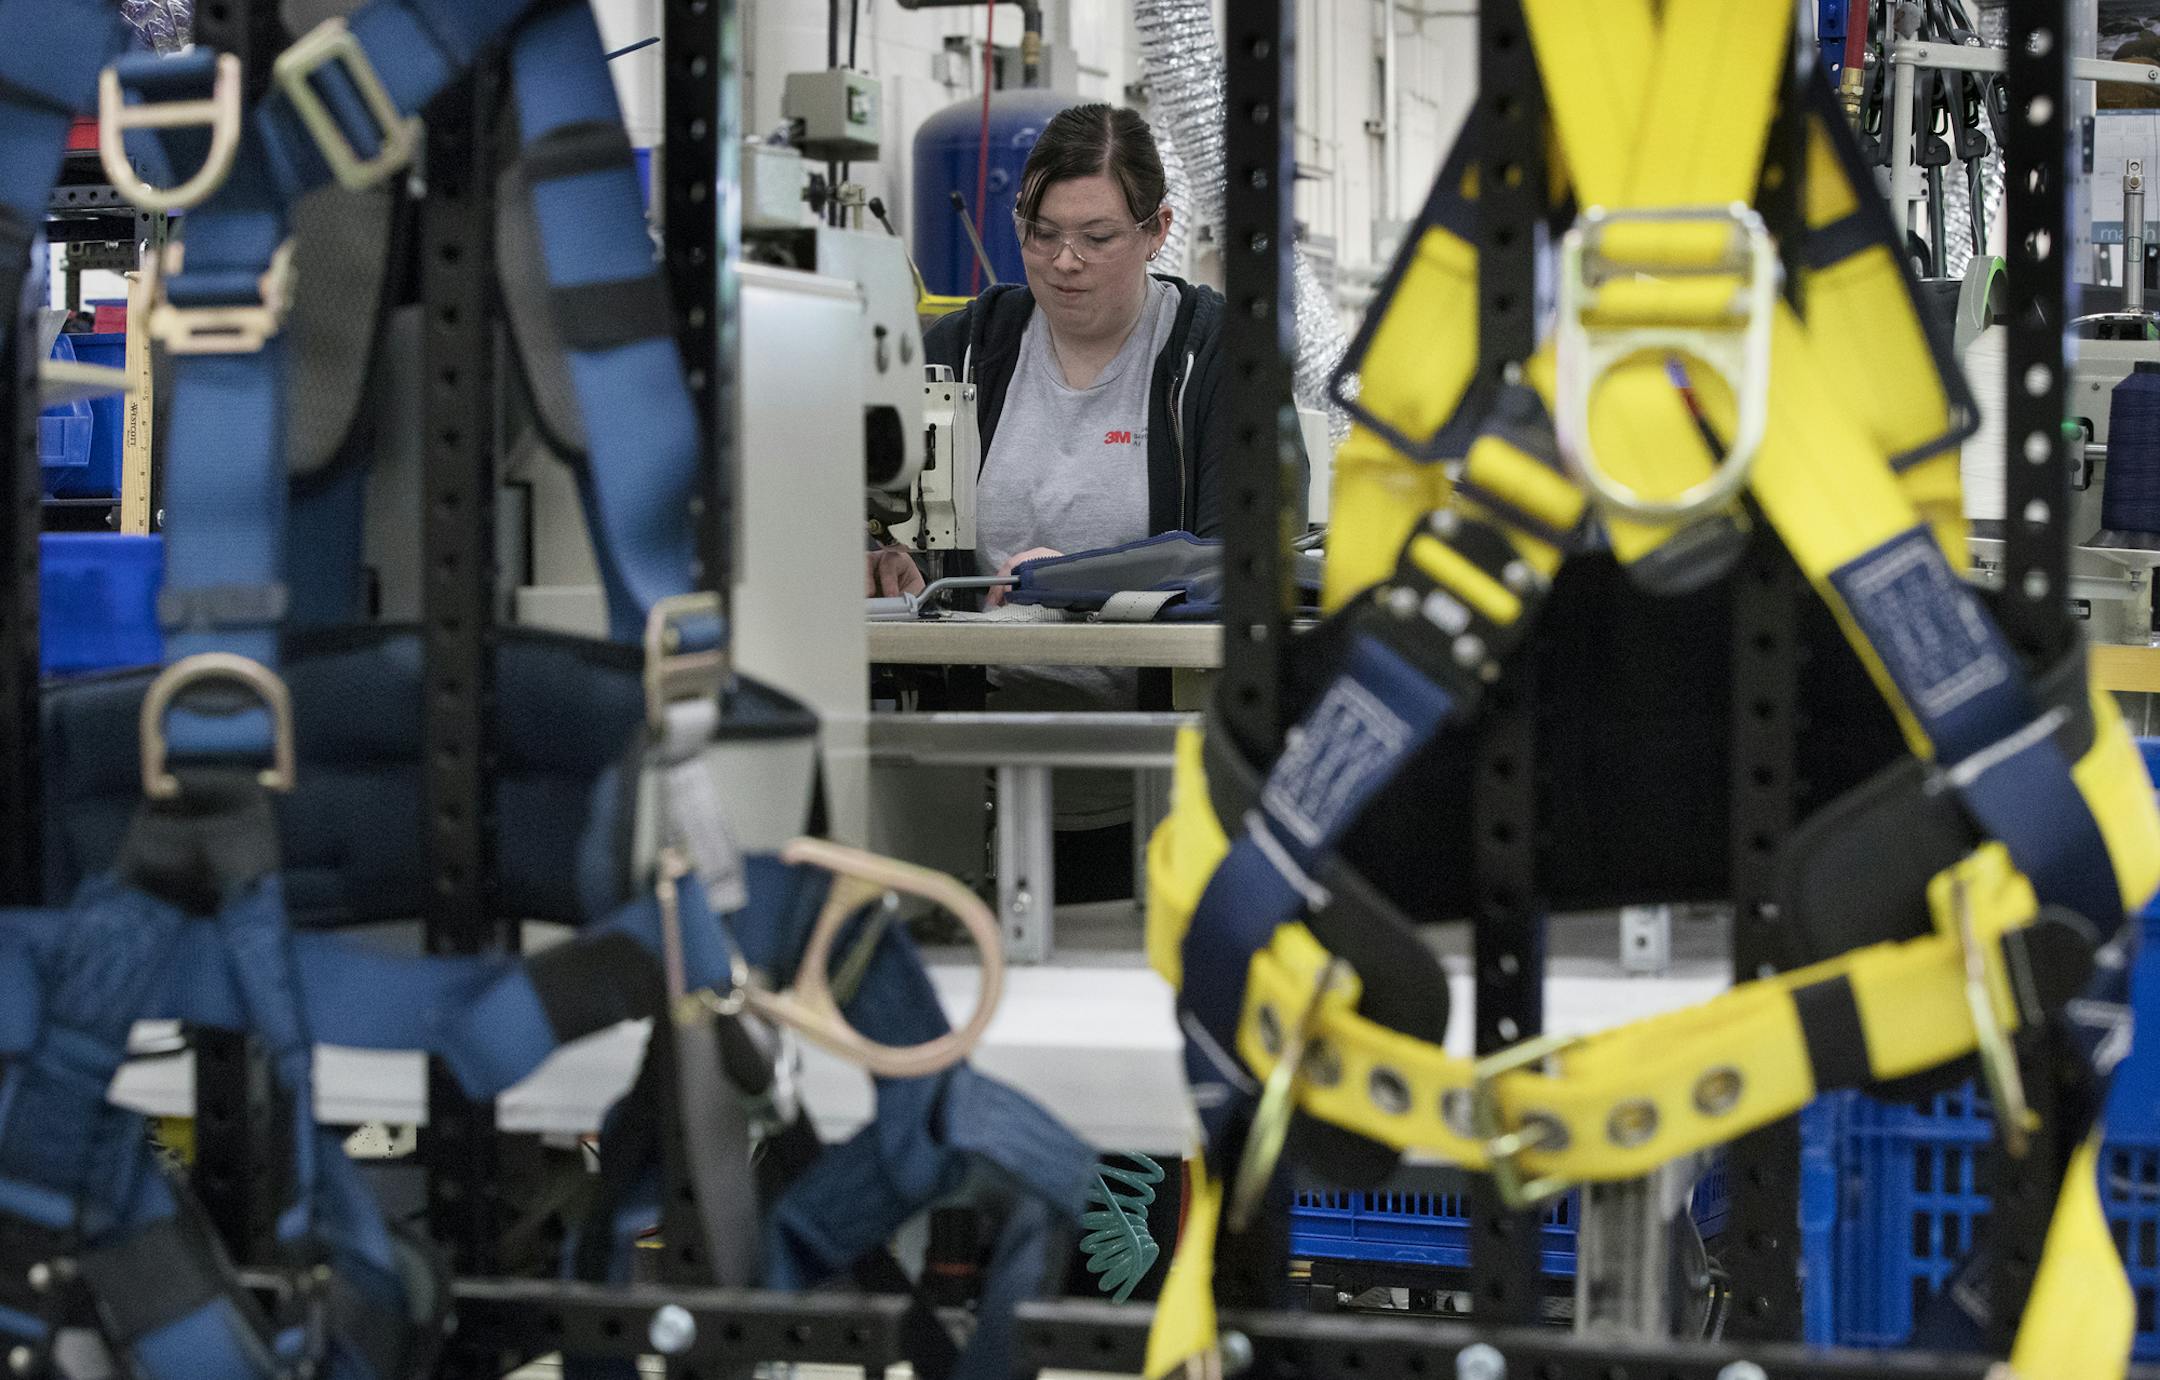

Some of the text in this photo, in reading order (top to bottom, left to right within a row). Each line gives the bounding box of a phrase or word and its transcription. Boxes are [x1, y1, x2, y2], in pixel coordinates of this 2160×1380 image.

[2100, 223, 2156, 240] mah
[129, 402, 138, 447] WESTCOTT
[1104, 430, 1131, 444] 3M
